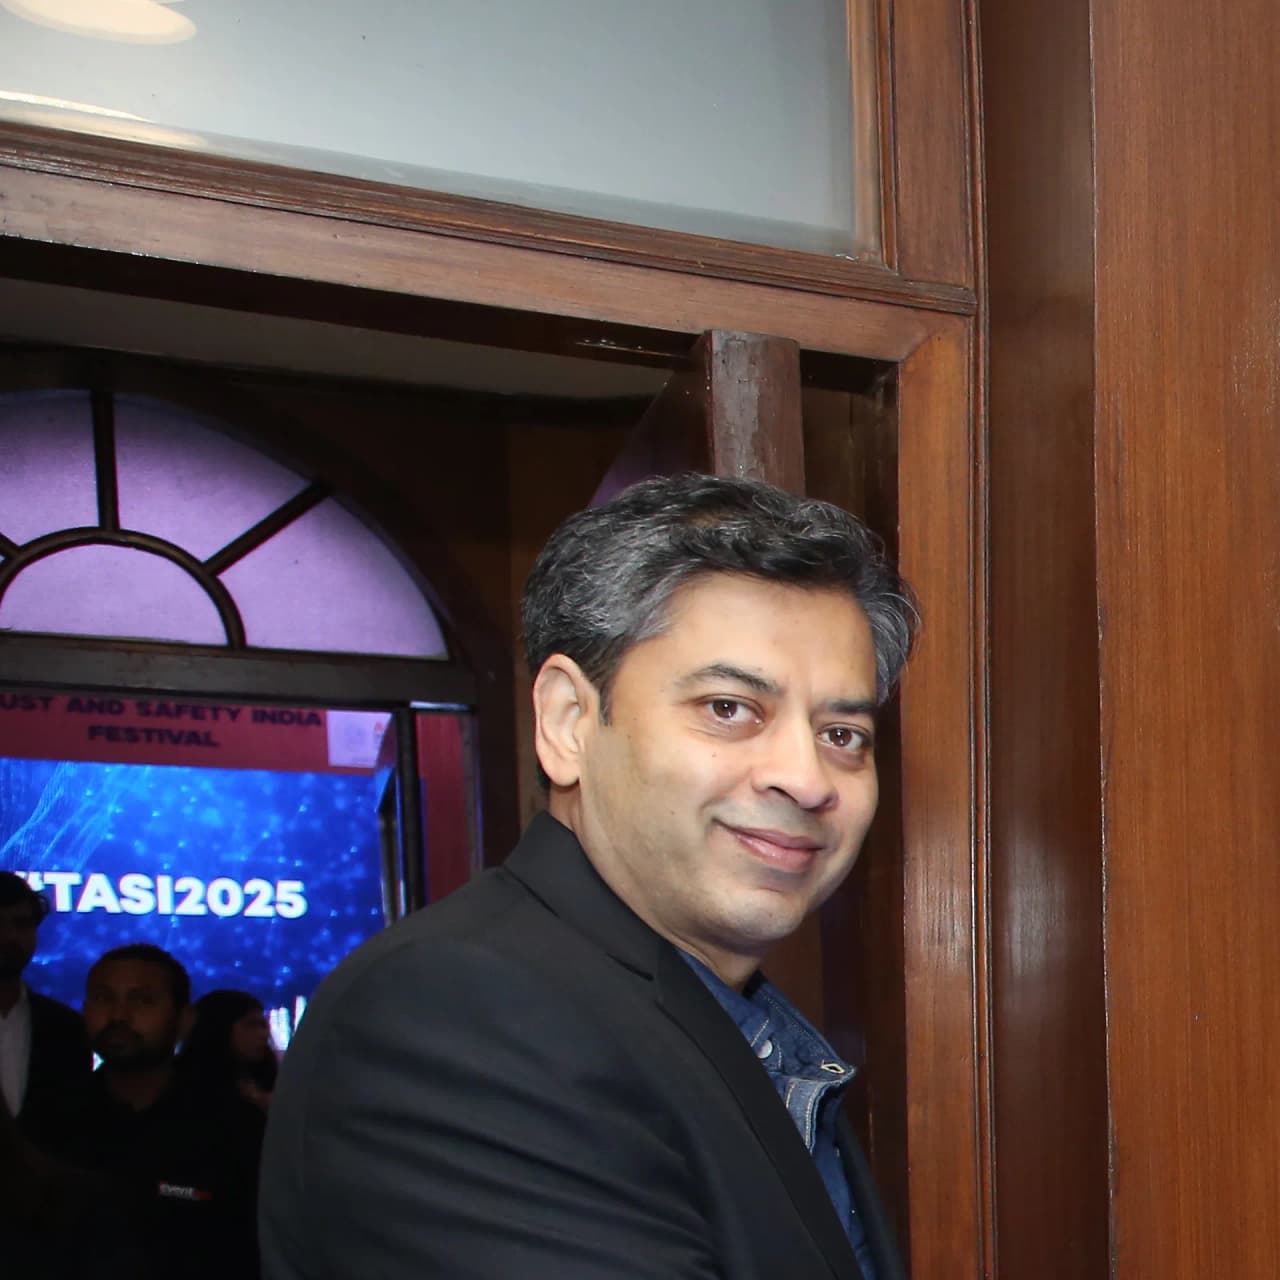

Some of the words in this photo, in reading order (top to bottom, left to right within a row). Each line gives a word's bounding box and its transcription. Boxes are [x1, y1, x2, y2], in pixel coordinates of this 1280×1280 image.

[66, 698, 123, 716] AND
[136, 702, 241, 722] SAFETY
[251, 707, 321, 727] INDIA
[88, 725, 220, 748] FESTIVAL
